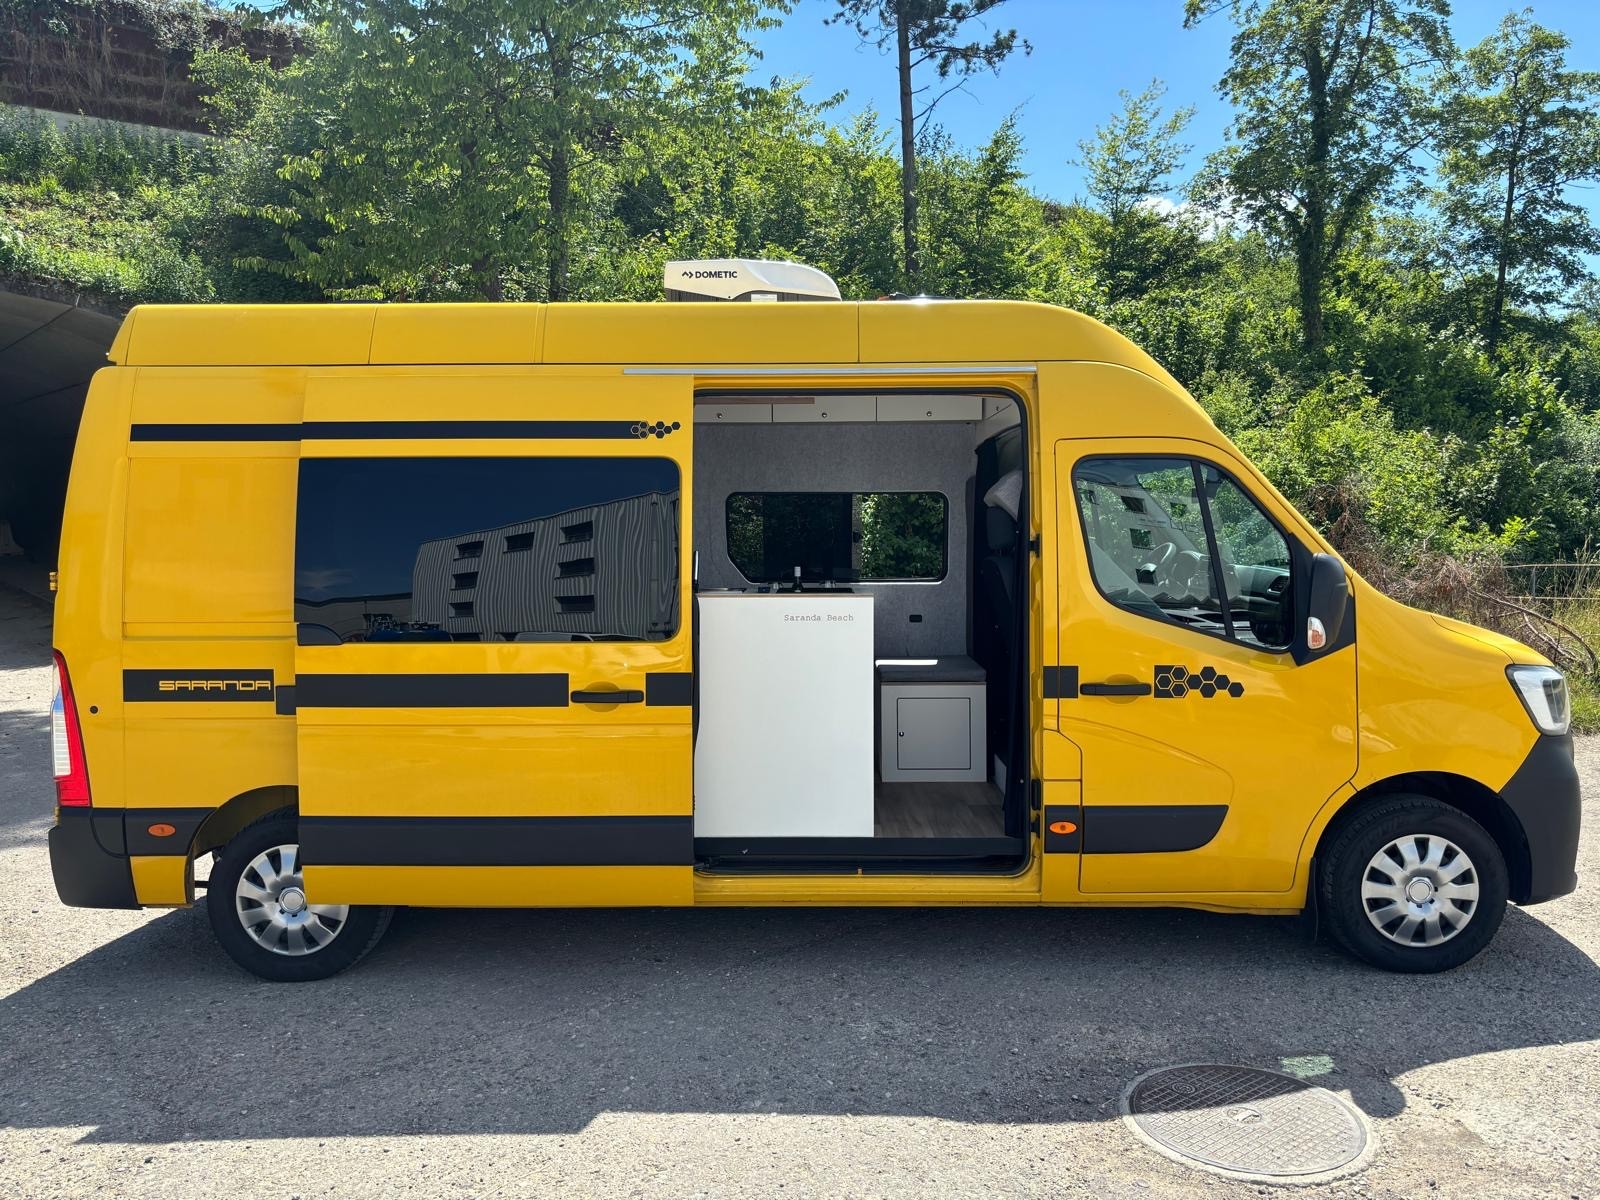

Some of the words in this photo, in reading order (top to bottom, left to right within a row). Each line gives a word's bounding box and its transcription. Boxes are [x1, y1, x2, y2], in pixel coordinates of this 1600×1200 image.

[695, 271, 738, 279] DOMETIC
[784, 614, 821, 622] Saranda
[827, 613, 854, 622] Beach
[158, 680, 271, 691] SARANDA
